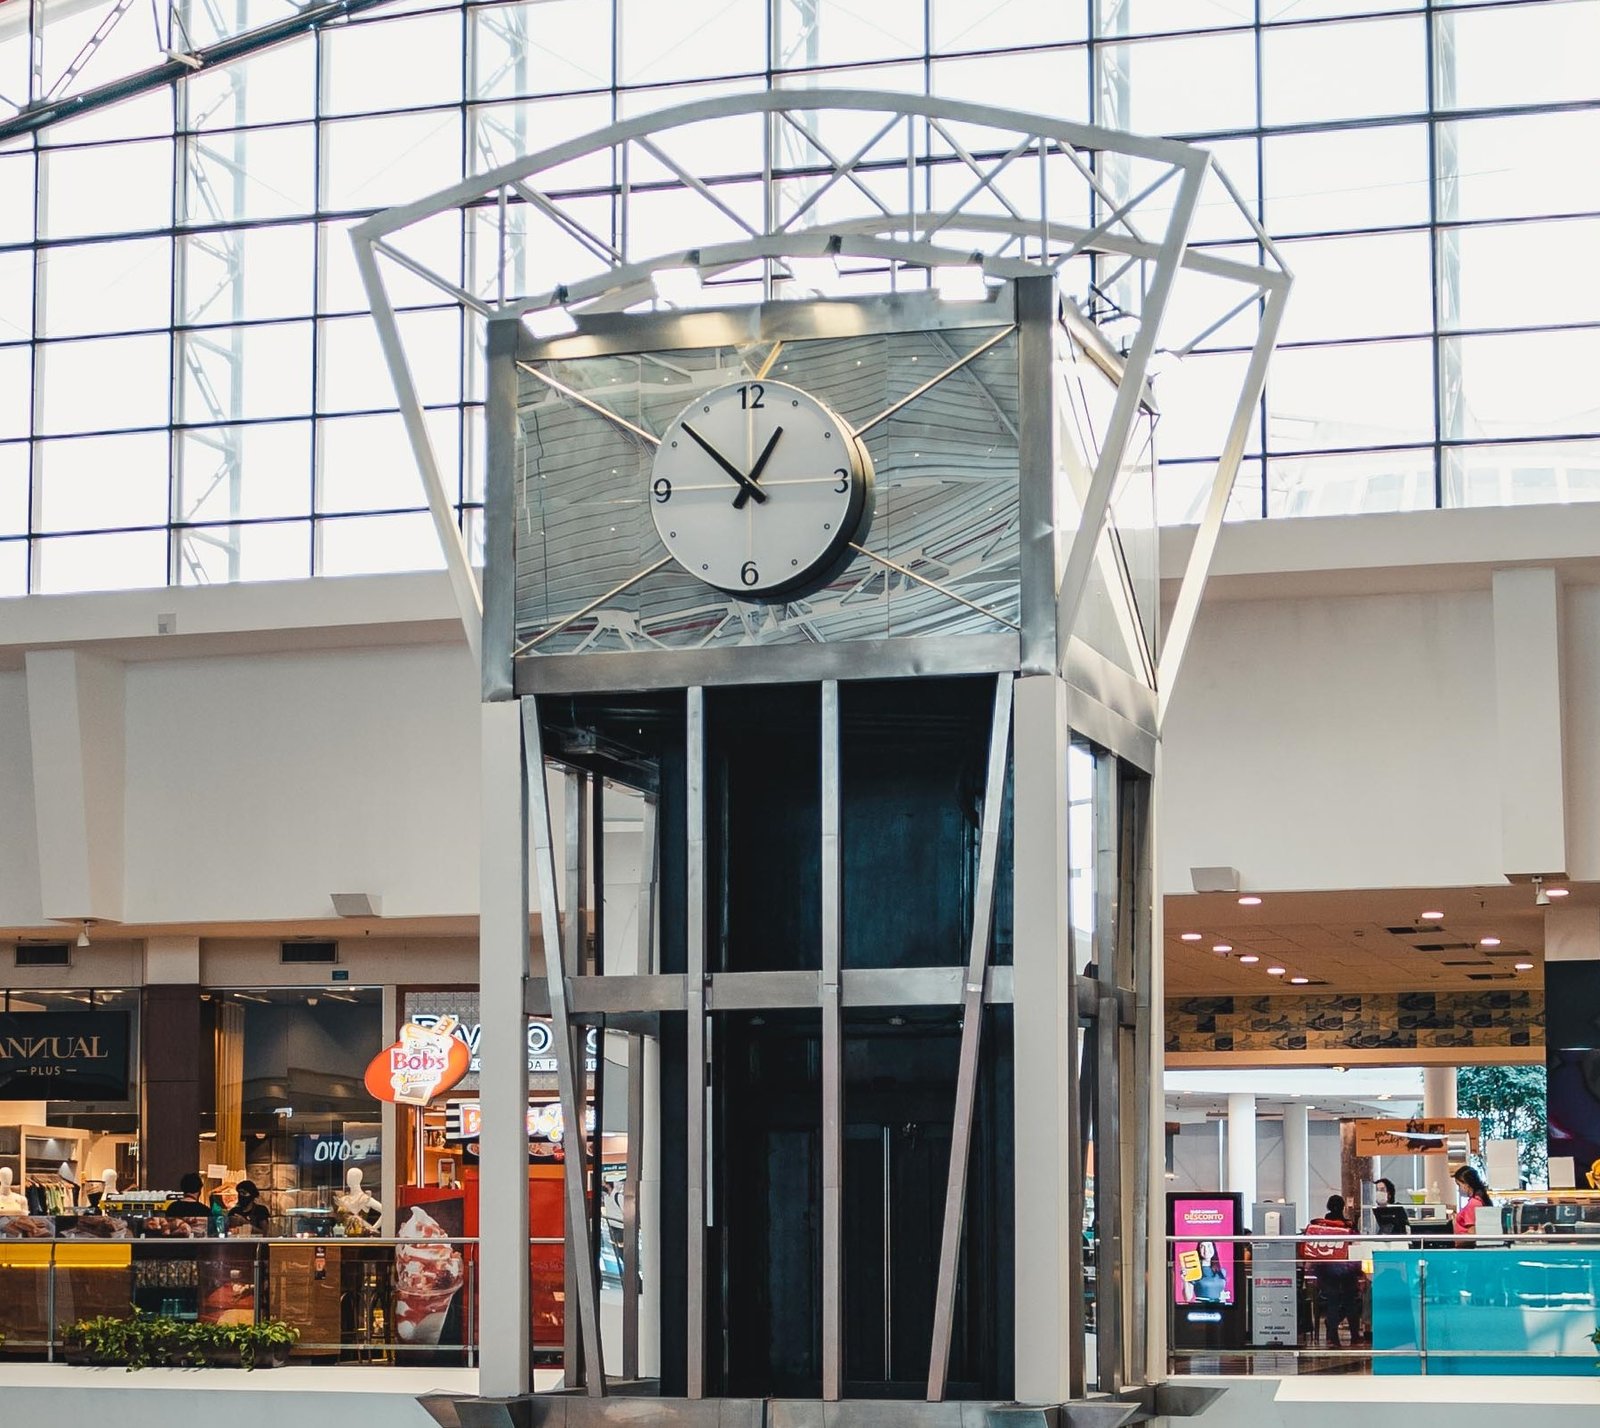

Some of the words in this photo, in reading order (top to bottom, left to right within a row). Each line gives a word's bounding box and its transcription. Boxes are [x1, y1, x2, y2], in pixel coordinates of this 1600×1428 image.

[736, 384, 765, 410] 12
[653, 478, 672, 503] 9
[833, 468, 849, 493] 3
[740, 561, 759, 586] 6
[30, 1066, 61, 1076] PLUS
